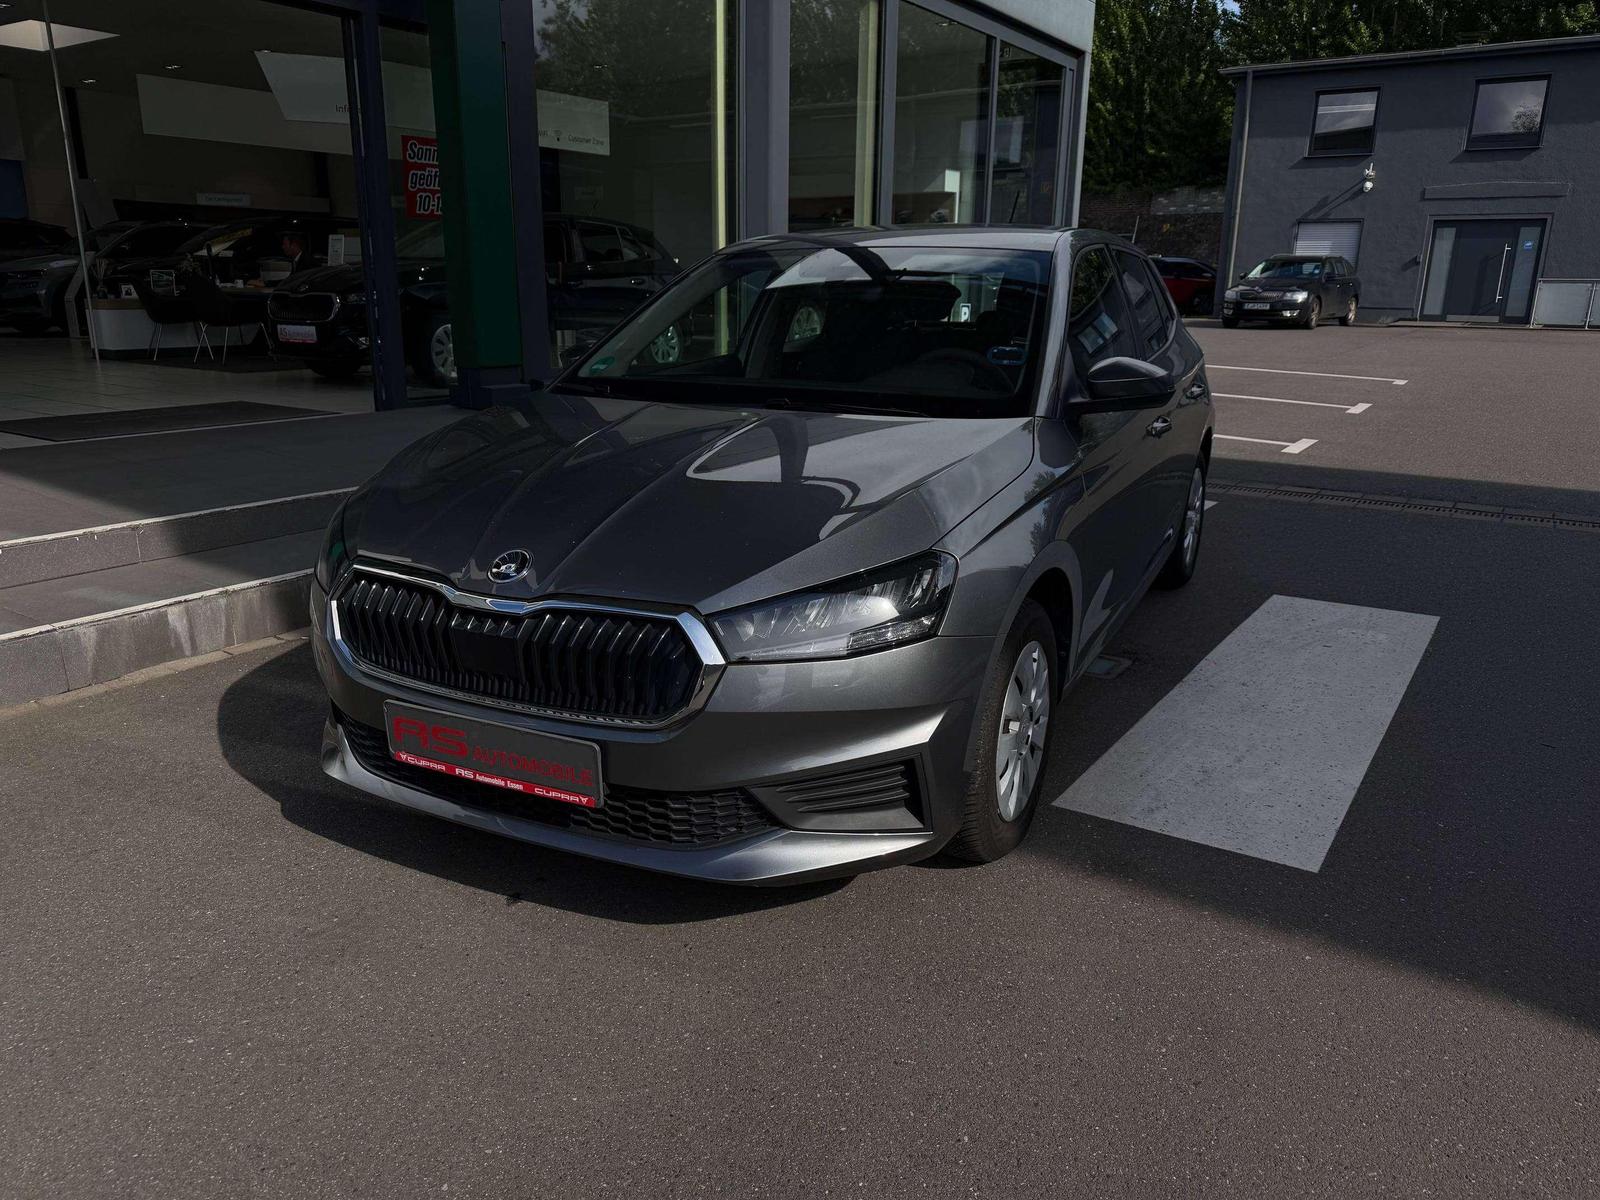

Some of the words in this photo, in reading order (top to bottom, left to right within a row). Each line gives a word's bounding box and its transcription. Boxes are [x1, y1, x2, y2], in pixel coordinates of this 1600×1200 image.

[394, 716, 468, 757] RS
[473, 746, 592, 787] AUTOMOBILE
[407, 756, 445, 771] CUPRA
[455, 768, 474, 779] RS
[475, 773, 504, 786] Automobile
[534, 787, 579, 803] CUPRA
